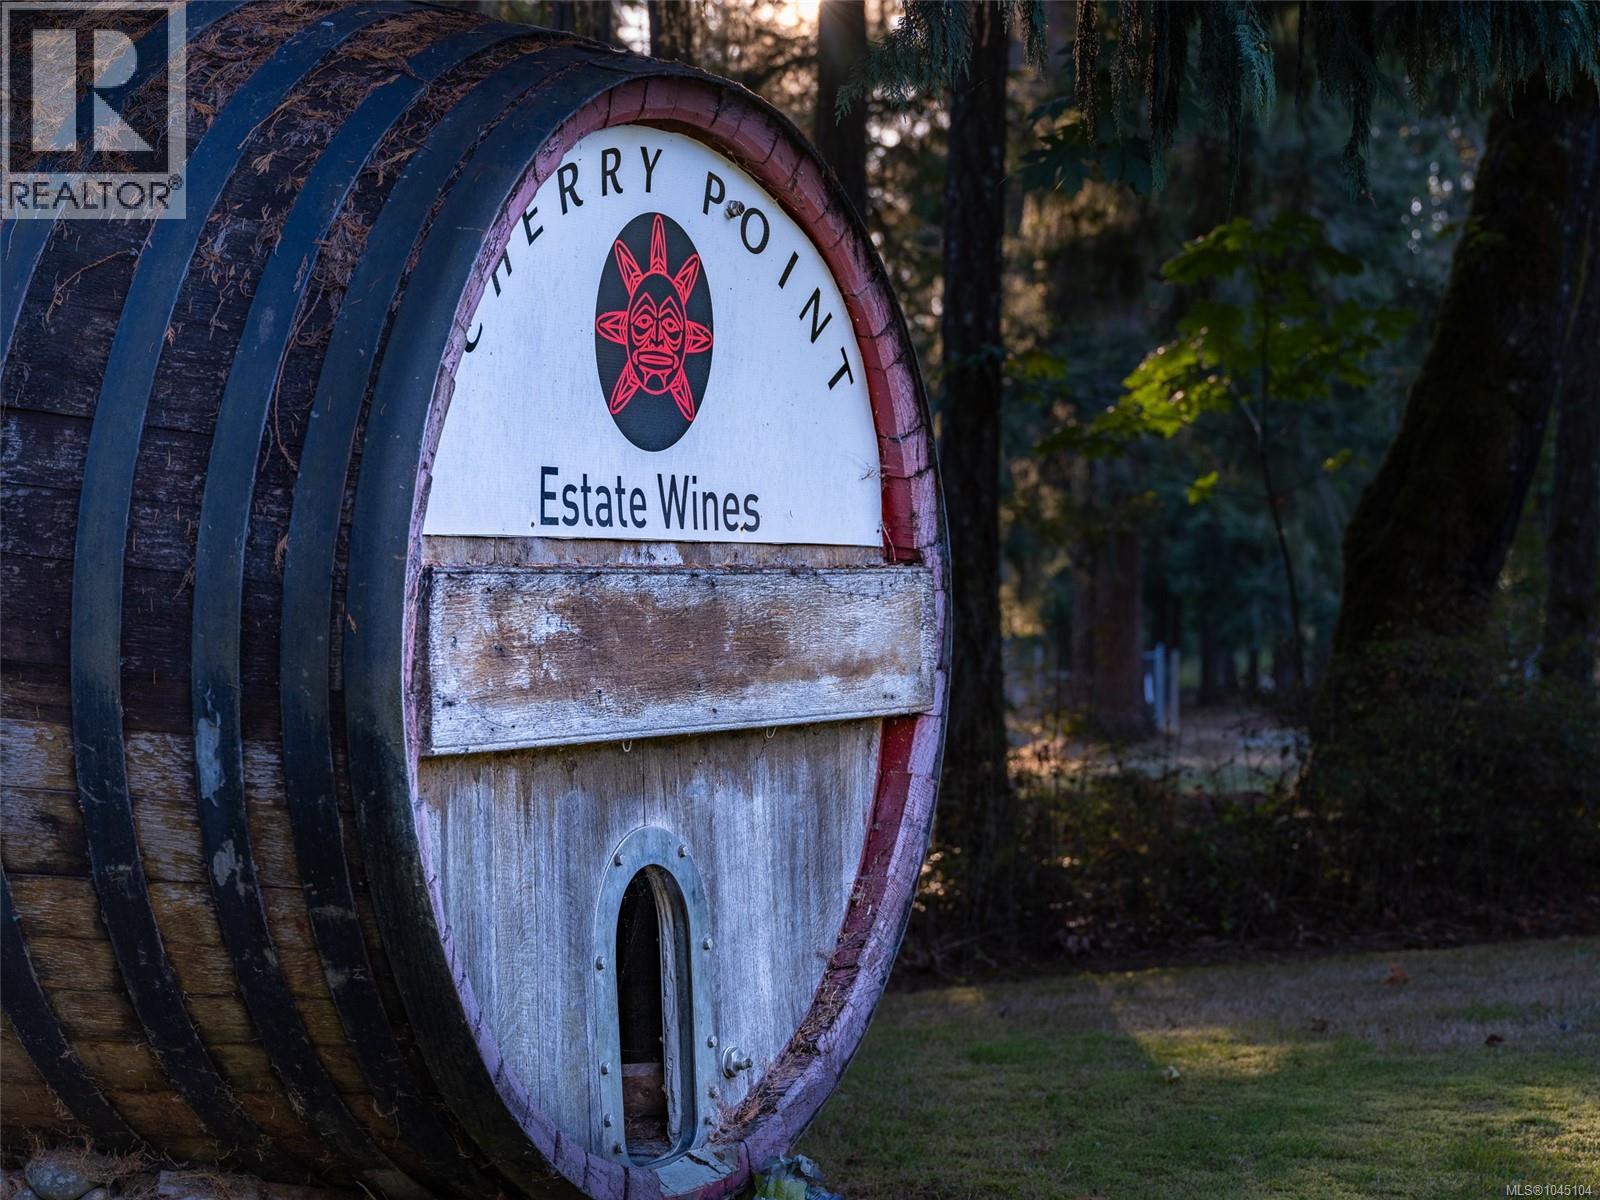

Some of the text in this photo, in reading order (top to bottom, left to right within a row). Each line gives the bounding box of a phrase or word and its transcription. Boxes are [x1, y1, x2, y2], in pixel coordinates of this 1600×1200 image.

[703, 171, 854, 390] POINT
[540, 466, 760, 531] Estate Wines
